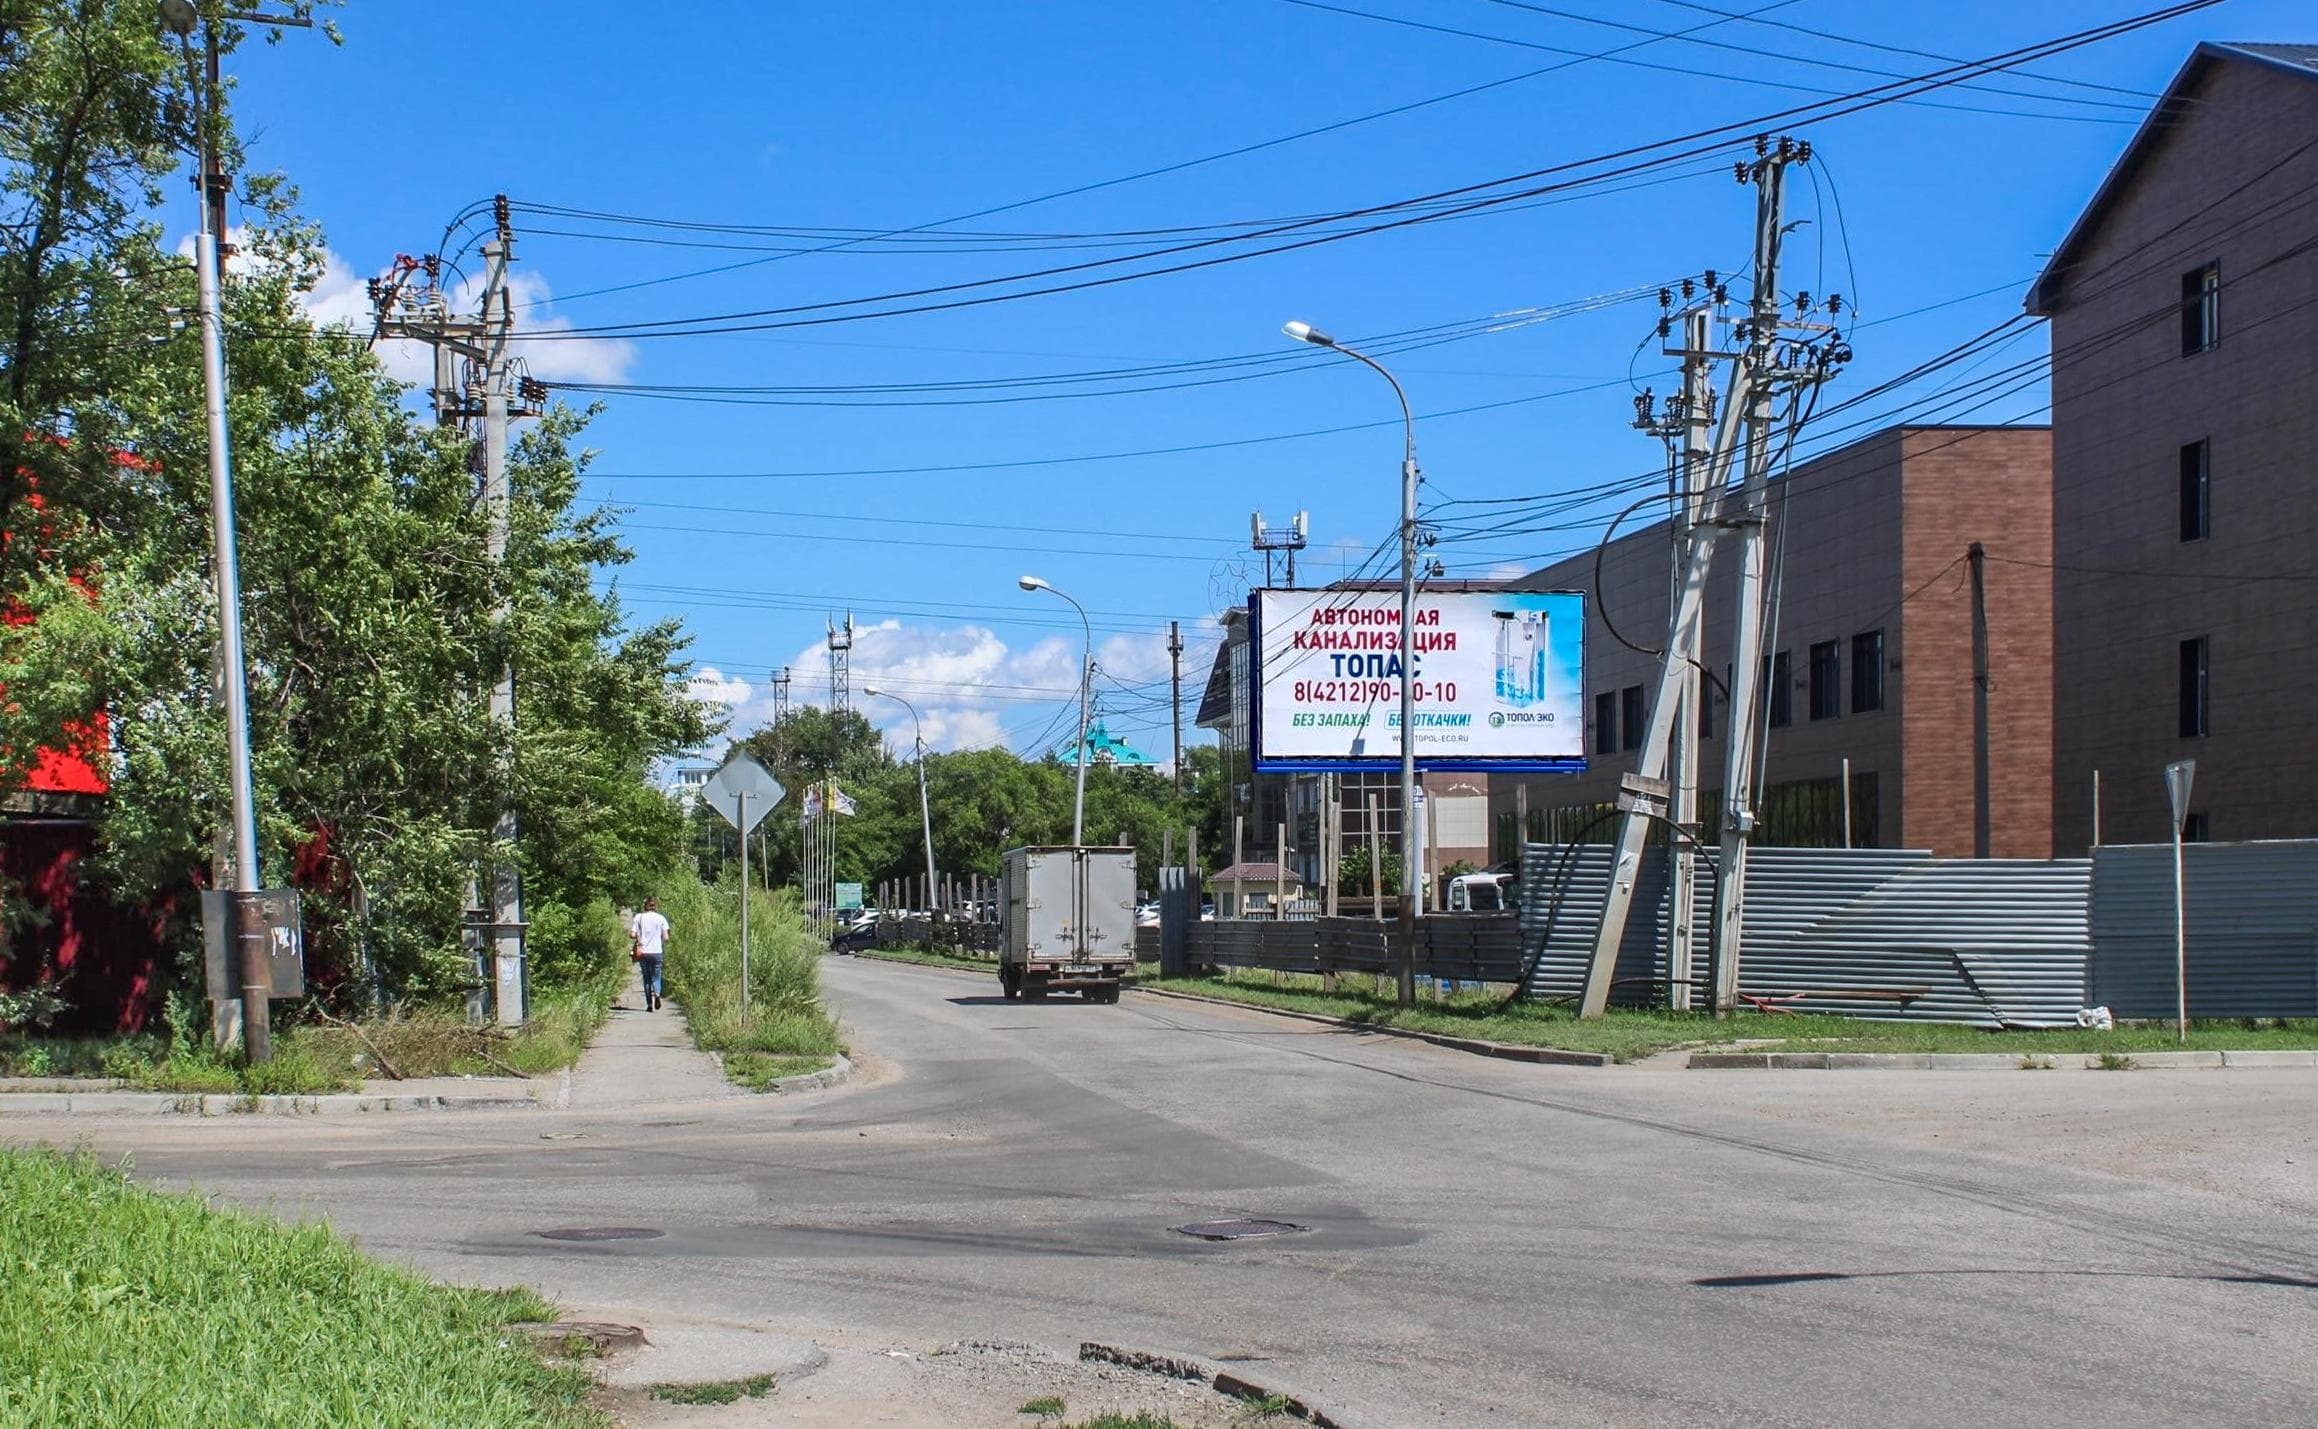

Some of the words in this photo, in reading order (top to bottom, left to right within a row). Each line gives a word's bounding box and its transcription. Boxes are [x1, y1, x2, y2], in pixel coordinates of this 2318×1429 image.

[1312, 608, 1440, 626] АВТОНОМАЯ
[1294, 680, 1456, 704] 8(4212)90-0-10
[1293, 713, 1315, 726] БЕЗ
[1318, 713, 1371, 726] ЗАПАХА!
[1388, 713, 1403, 726] БЕ
[1413, 713, 1472, 726] ОТКАЧКИ!
